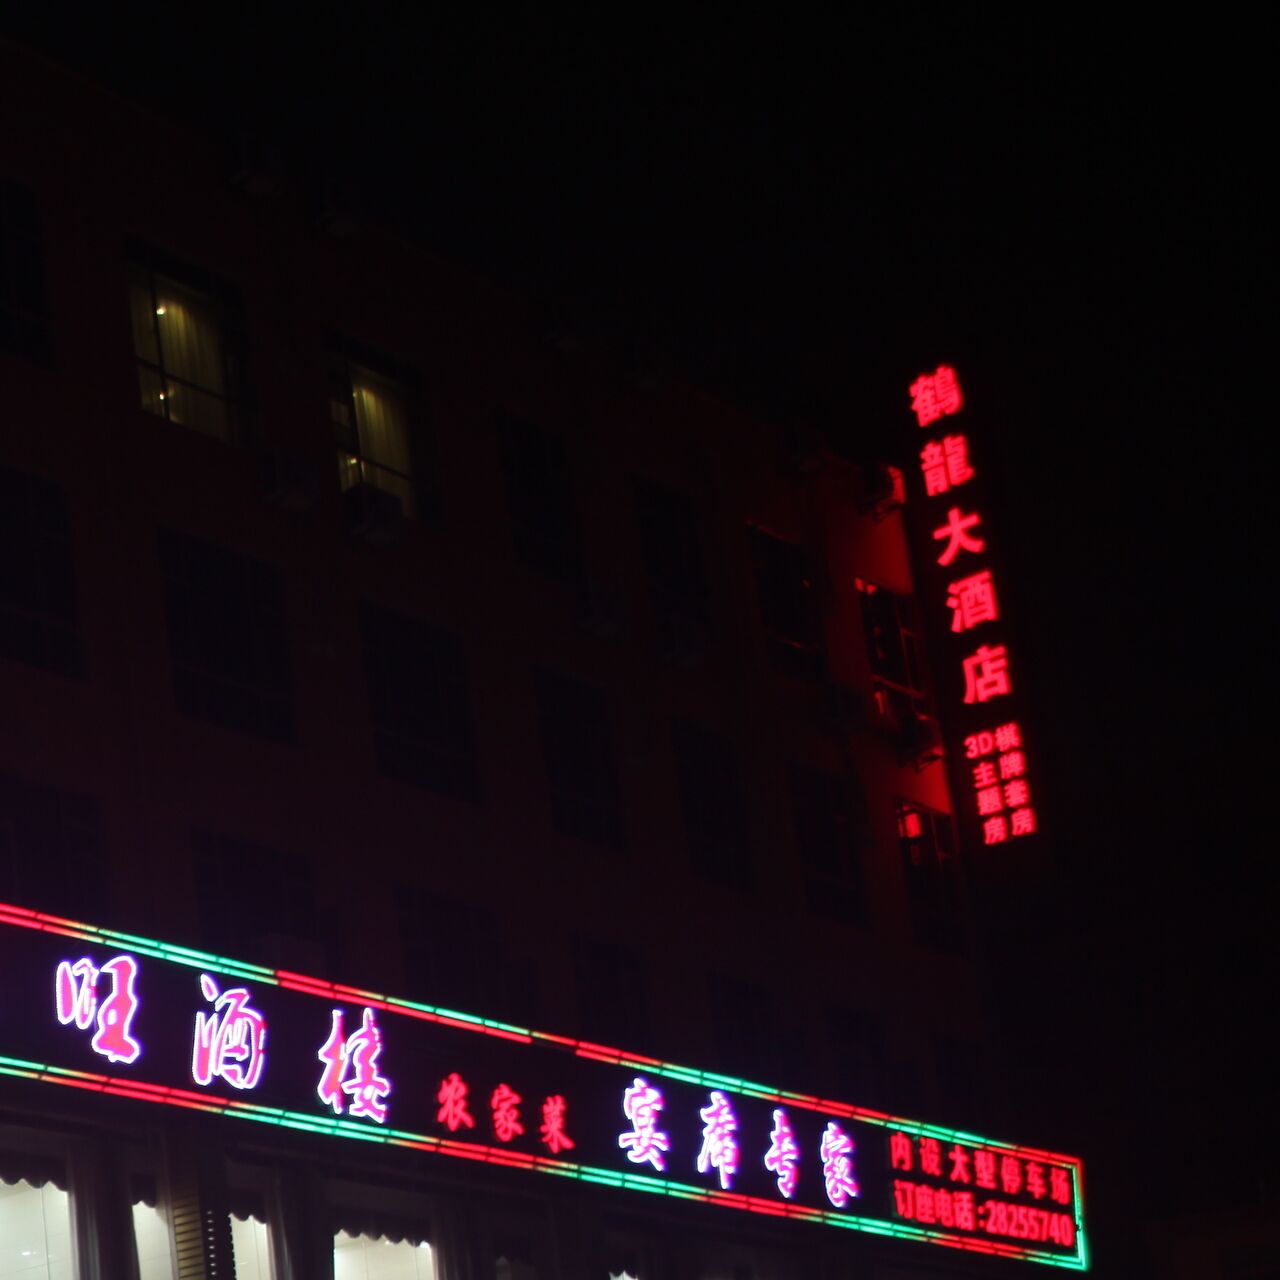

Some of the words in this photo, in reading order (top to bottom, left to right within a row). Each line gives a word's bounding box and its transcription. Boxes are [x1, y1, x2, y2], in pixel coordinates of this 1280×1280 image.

[890, 1131, 1072, 1206] 内设大型停车场
